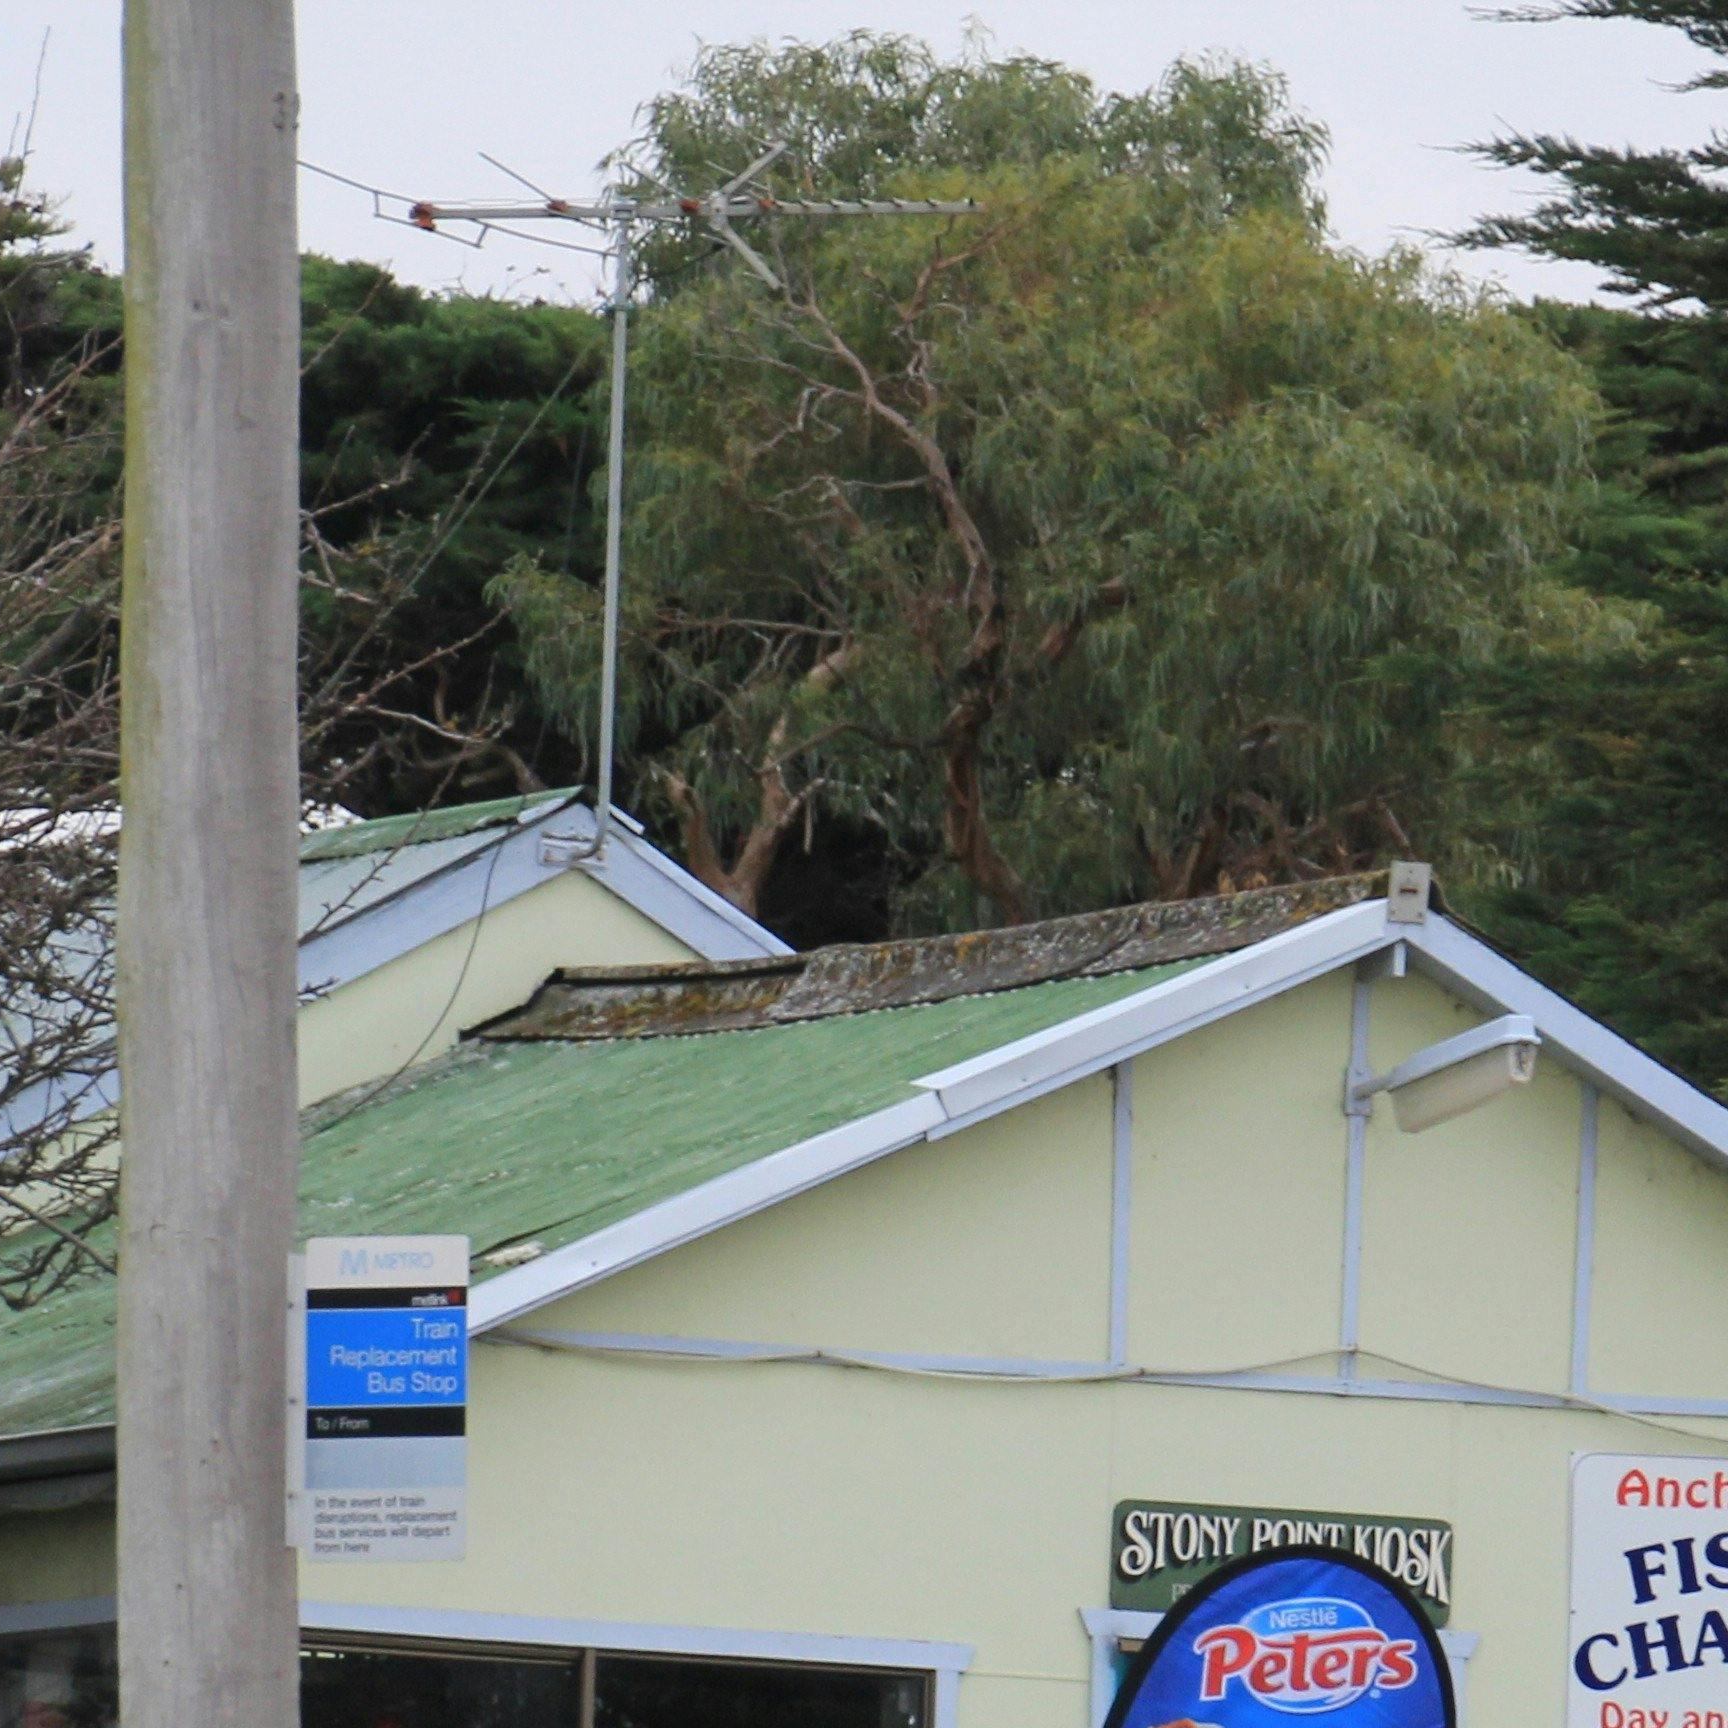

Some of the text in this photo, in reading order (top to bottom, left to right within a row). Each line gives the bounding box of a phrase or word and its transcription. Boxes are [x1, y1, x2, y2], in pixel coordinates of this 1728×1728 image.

[411, 1317, 457, 1339] Train
[329, 1345, 457, 1370] Replacement
[367, 1371, 458, 1395] Bus Stop
[328, 1496, 347, 1508] the
[349, 1497, 382, 1508] event
[384, 1495, 397, 1507] of
[399, 1496, 426, 1507] train
[385, 1510, 457, 1523] replacement
[314, 1525, 451, 1540] bus services will depart
[1118, 1509, 1452, 1606] STONY POINT KIOSK
[1194, 1624, 1416, 1698] Peters
